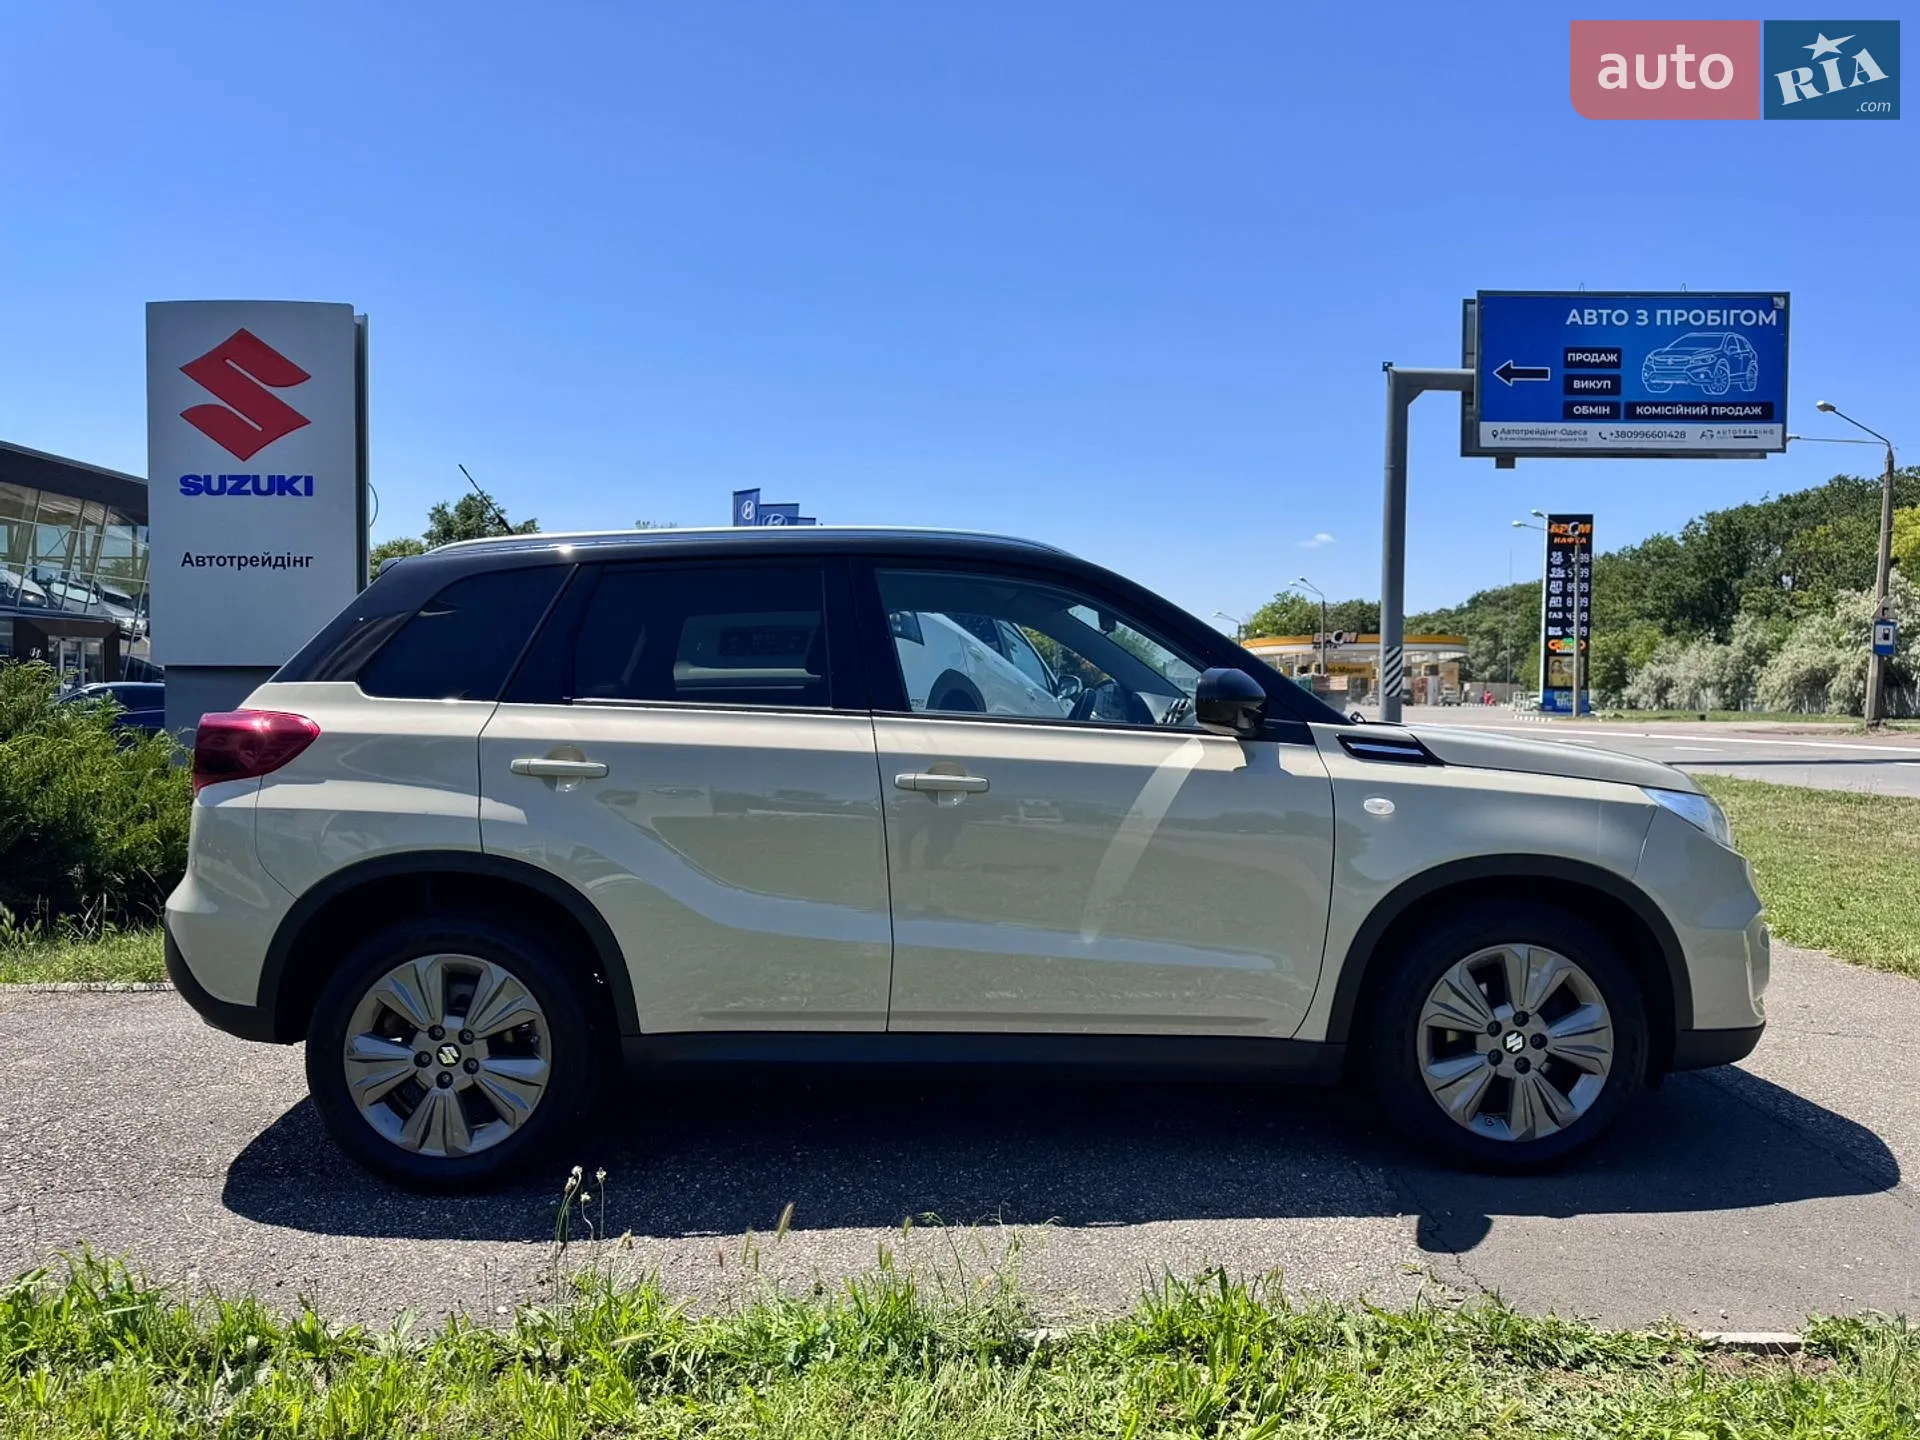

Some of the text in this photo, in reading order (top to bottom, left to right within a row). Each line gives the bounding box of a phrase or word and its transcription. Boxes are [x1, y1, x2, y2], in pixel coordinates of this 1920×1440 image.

[1565, 308, 1629, 326] АВТО
[1655, 308, 1777, 327] ПРОБІГОМ
[1567, 352, 1618, 364] ПРОДАЖ
[1573, 379, 1611, 390] ВИКУП
[1573, 404, 1610, 415] ОБМІН
[1636, 403, 1762, 416] КОМІСІЙНИЙ ПРОДАЖ
[1609, 429, 1686, 440] +380996601428
[179, 474, 314, 497] SUZUKI
[180, 551, 314, 571] Автотрейдінг
